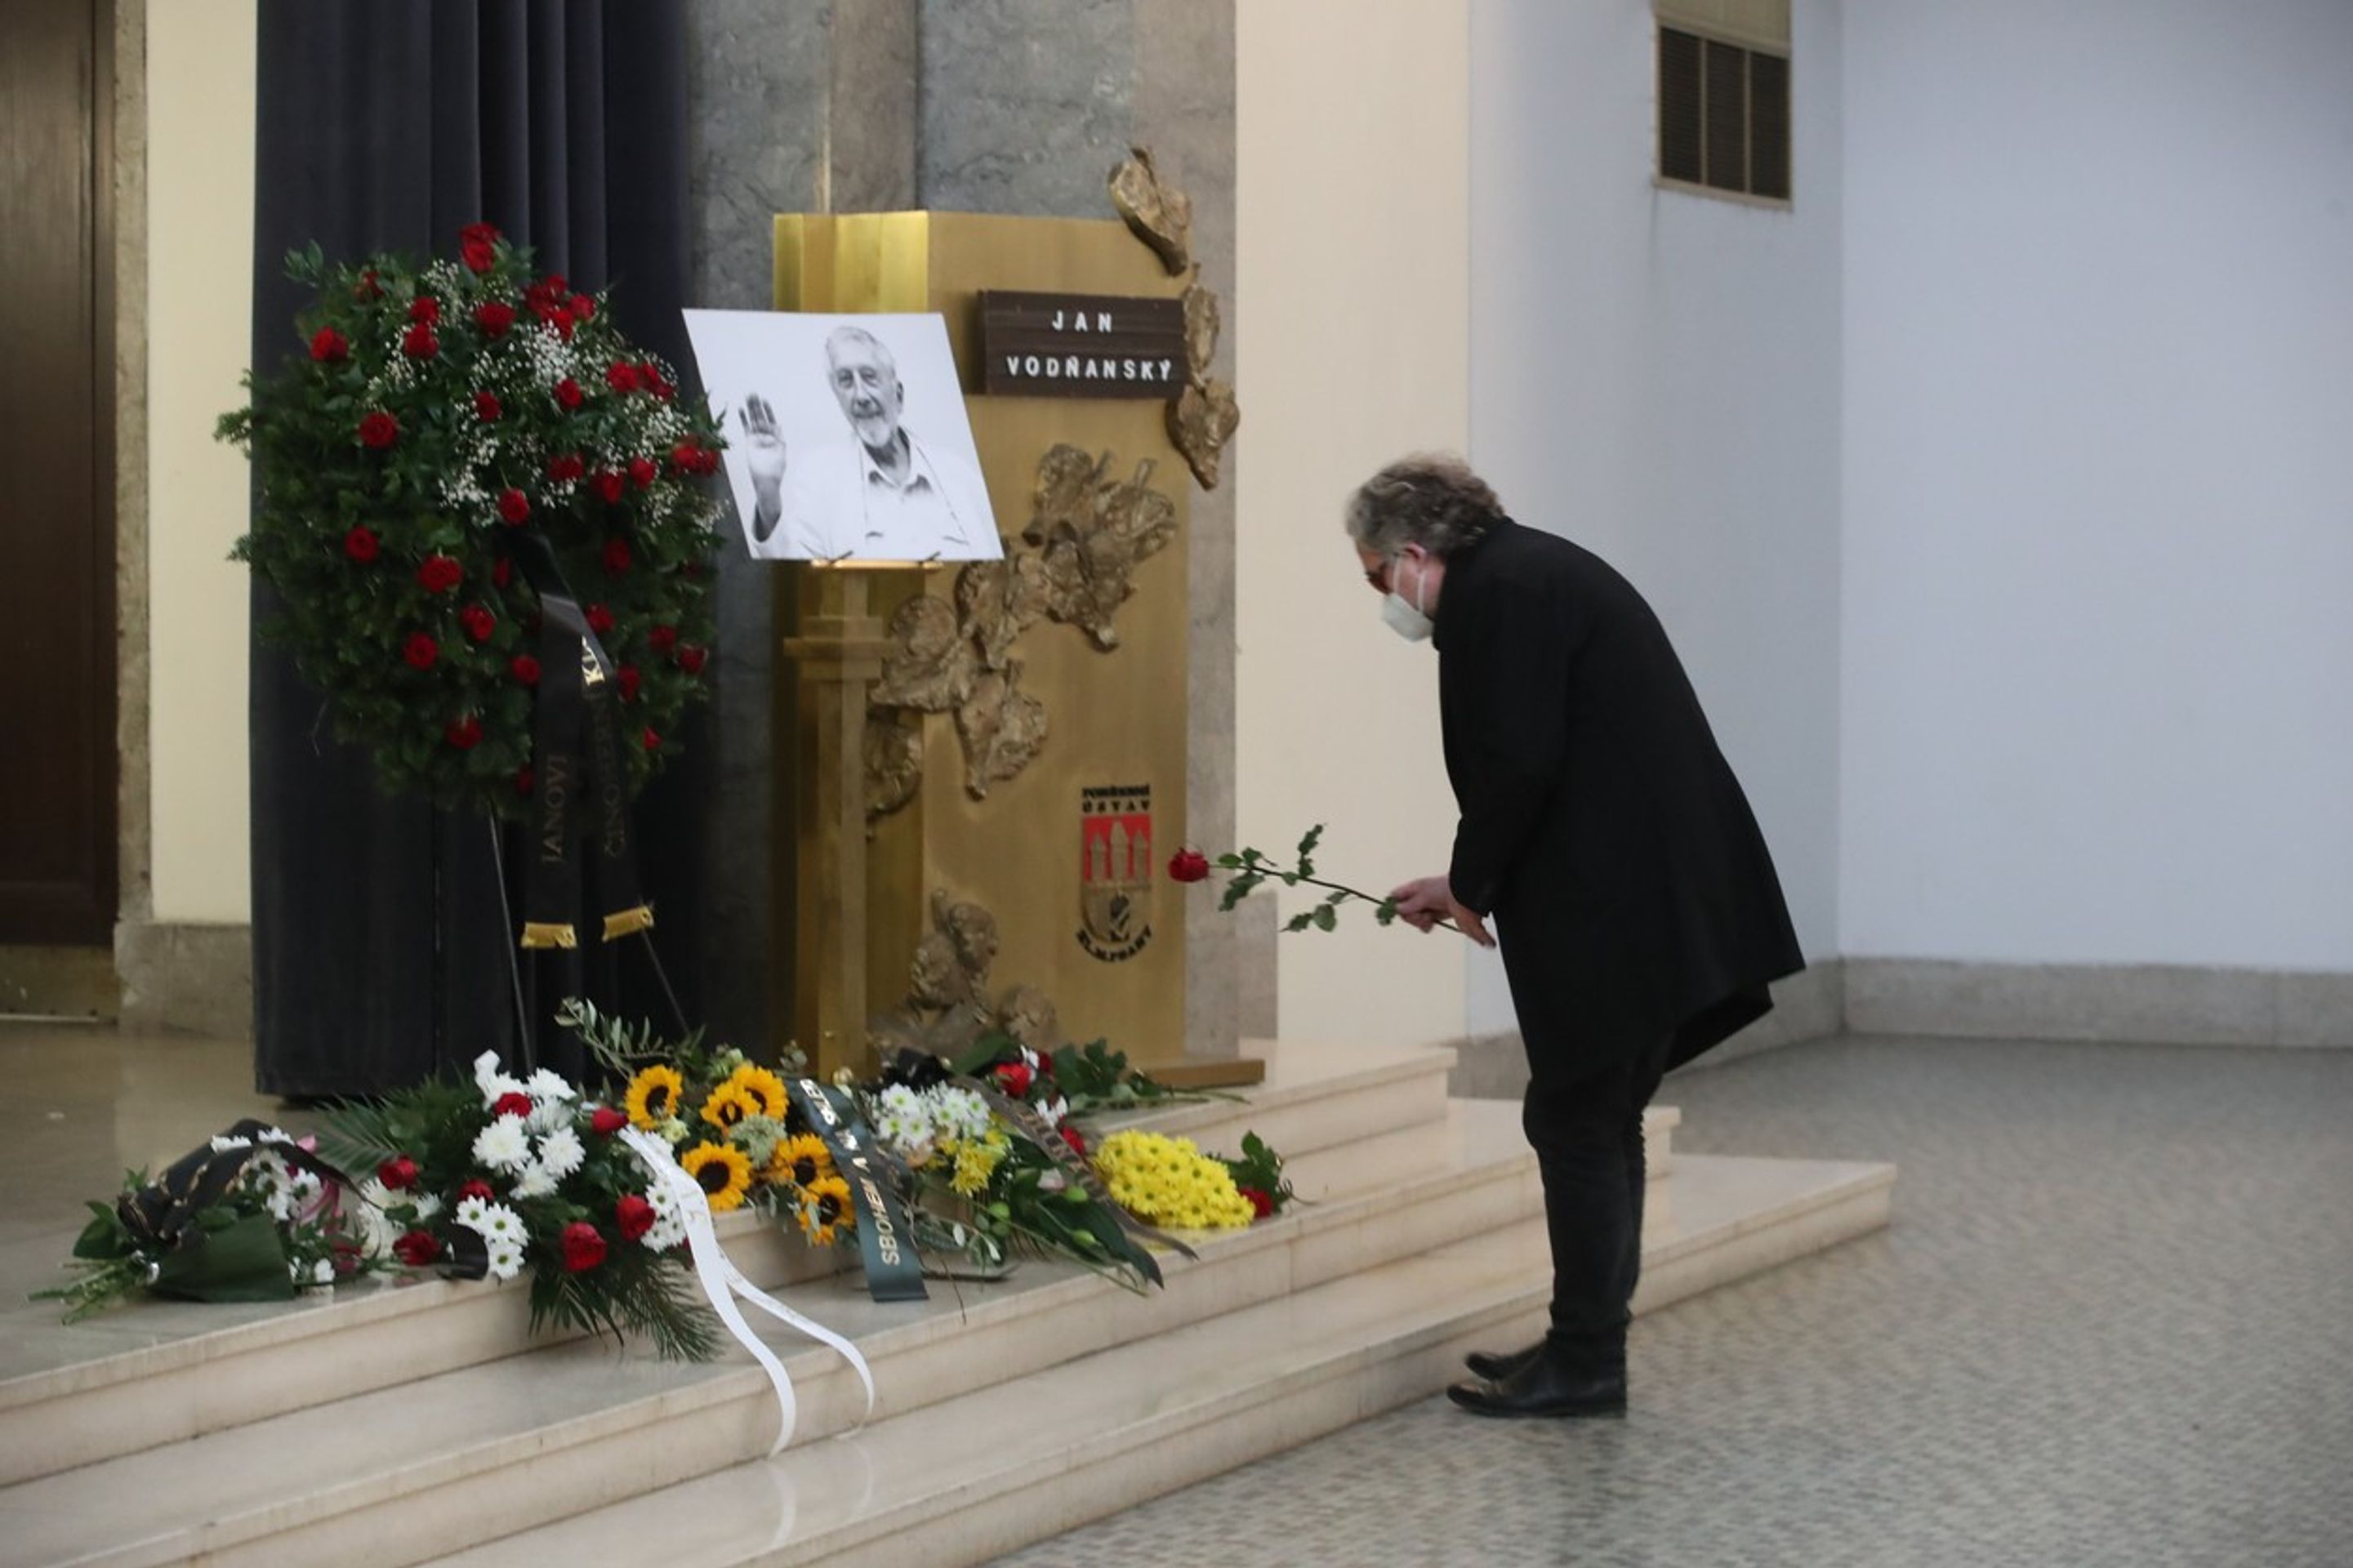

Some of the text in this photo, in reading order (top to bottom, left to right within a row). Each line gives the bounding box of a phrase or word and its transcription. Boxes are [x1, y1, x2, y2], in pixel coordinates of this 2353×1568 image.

[1052, 310, 1112, 332] JAN
[1006, 355, 1172, 381] VODŇANSKÝ
[541, 753, 569, 863] JANOVI
